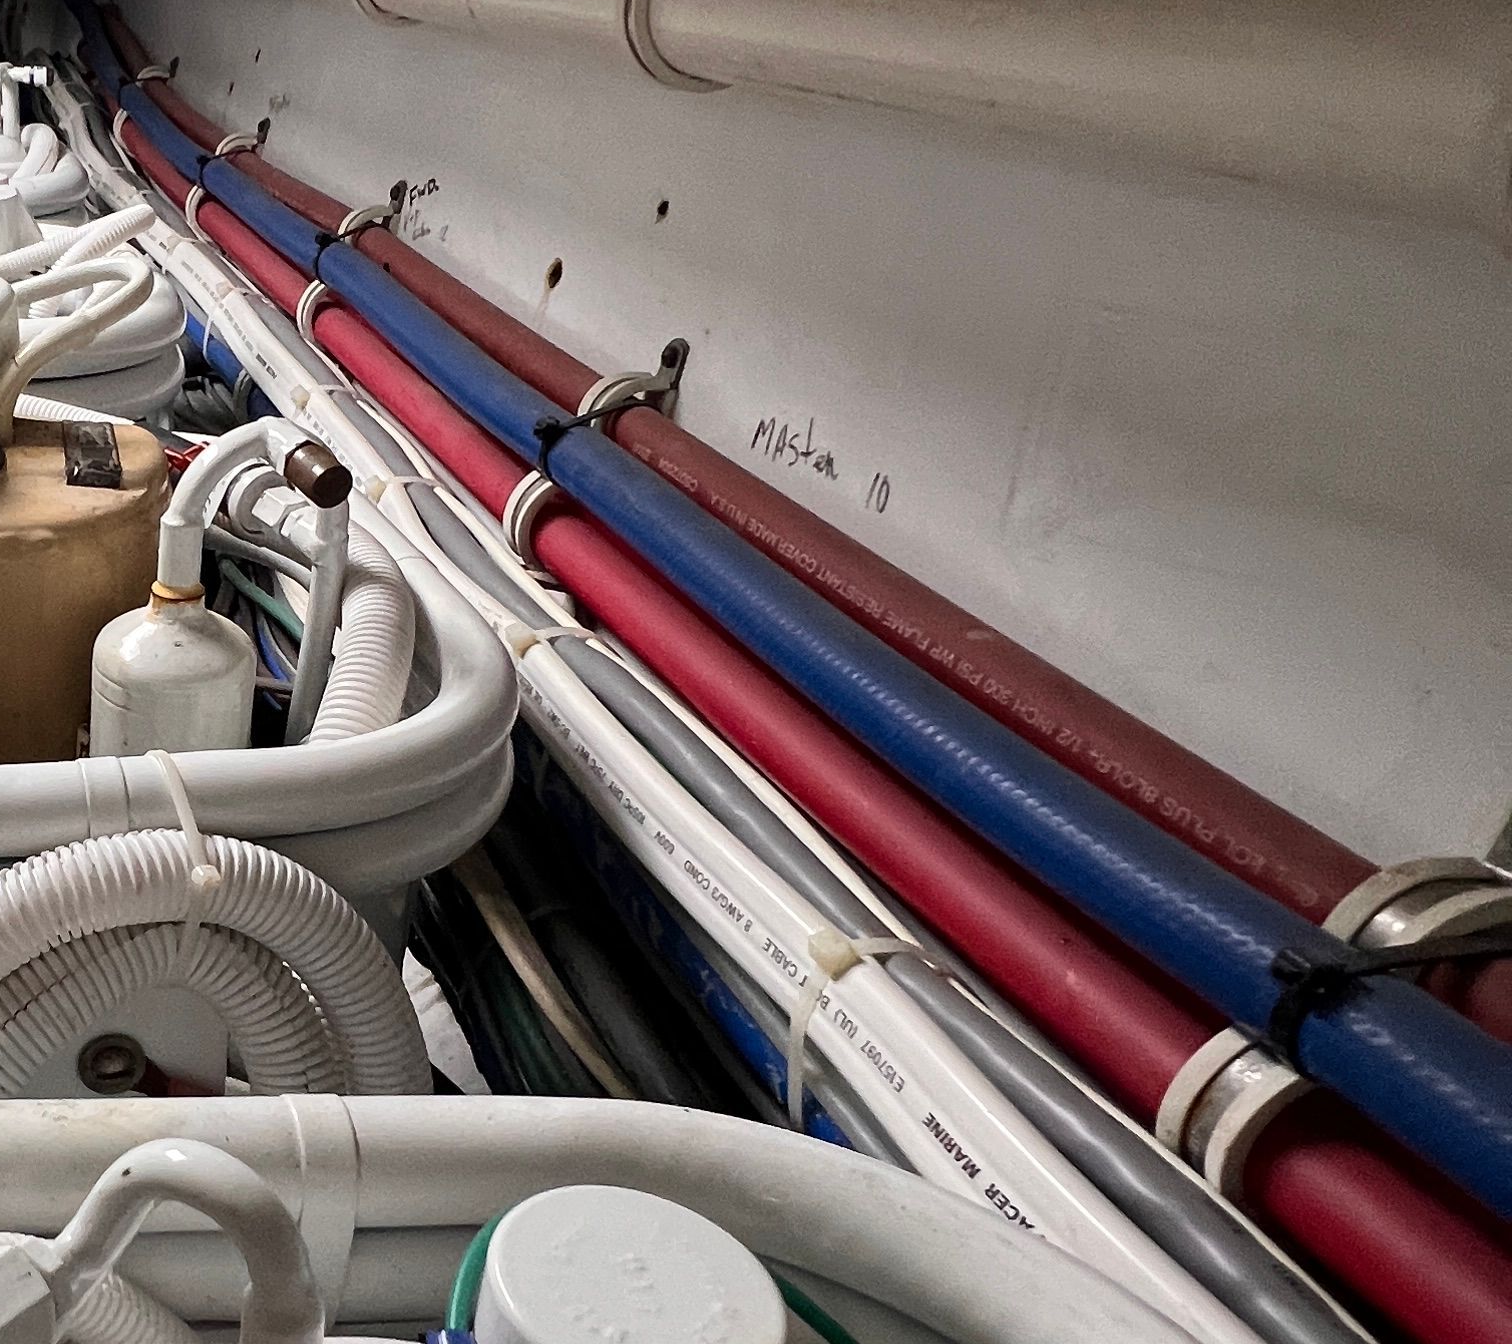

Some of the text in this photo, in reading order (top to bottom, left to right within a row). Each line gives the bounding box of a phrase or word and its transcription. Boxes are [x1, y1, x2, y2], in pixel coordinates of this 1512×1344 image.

[816, 565, 884, 618] RESISTANT
[882, 610, 931, 650] FLAME
[953, 659, 983, 686] PSI
[680, 860, 711, 891] COND
[760, 938, 799, 977] CABLE
[831, 1009, 859, 1039] (UL)
[921, 1112, 980, 1179] MARINE
[982, 1183, 1044, 1245] ACER
